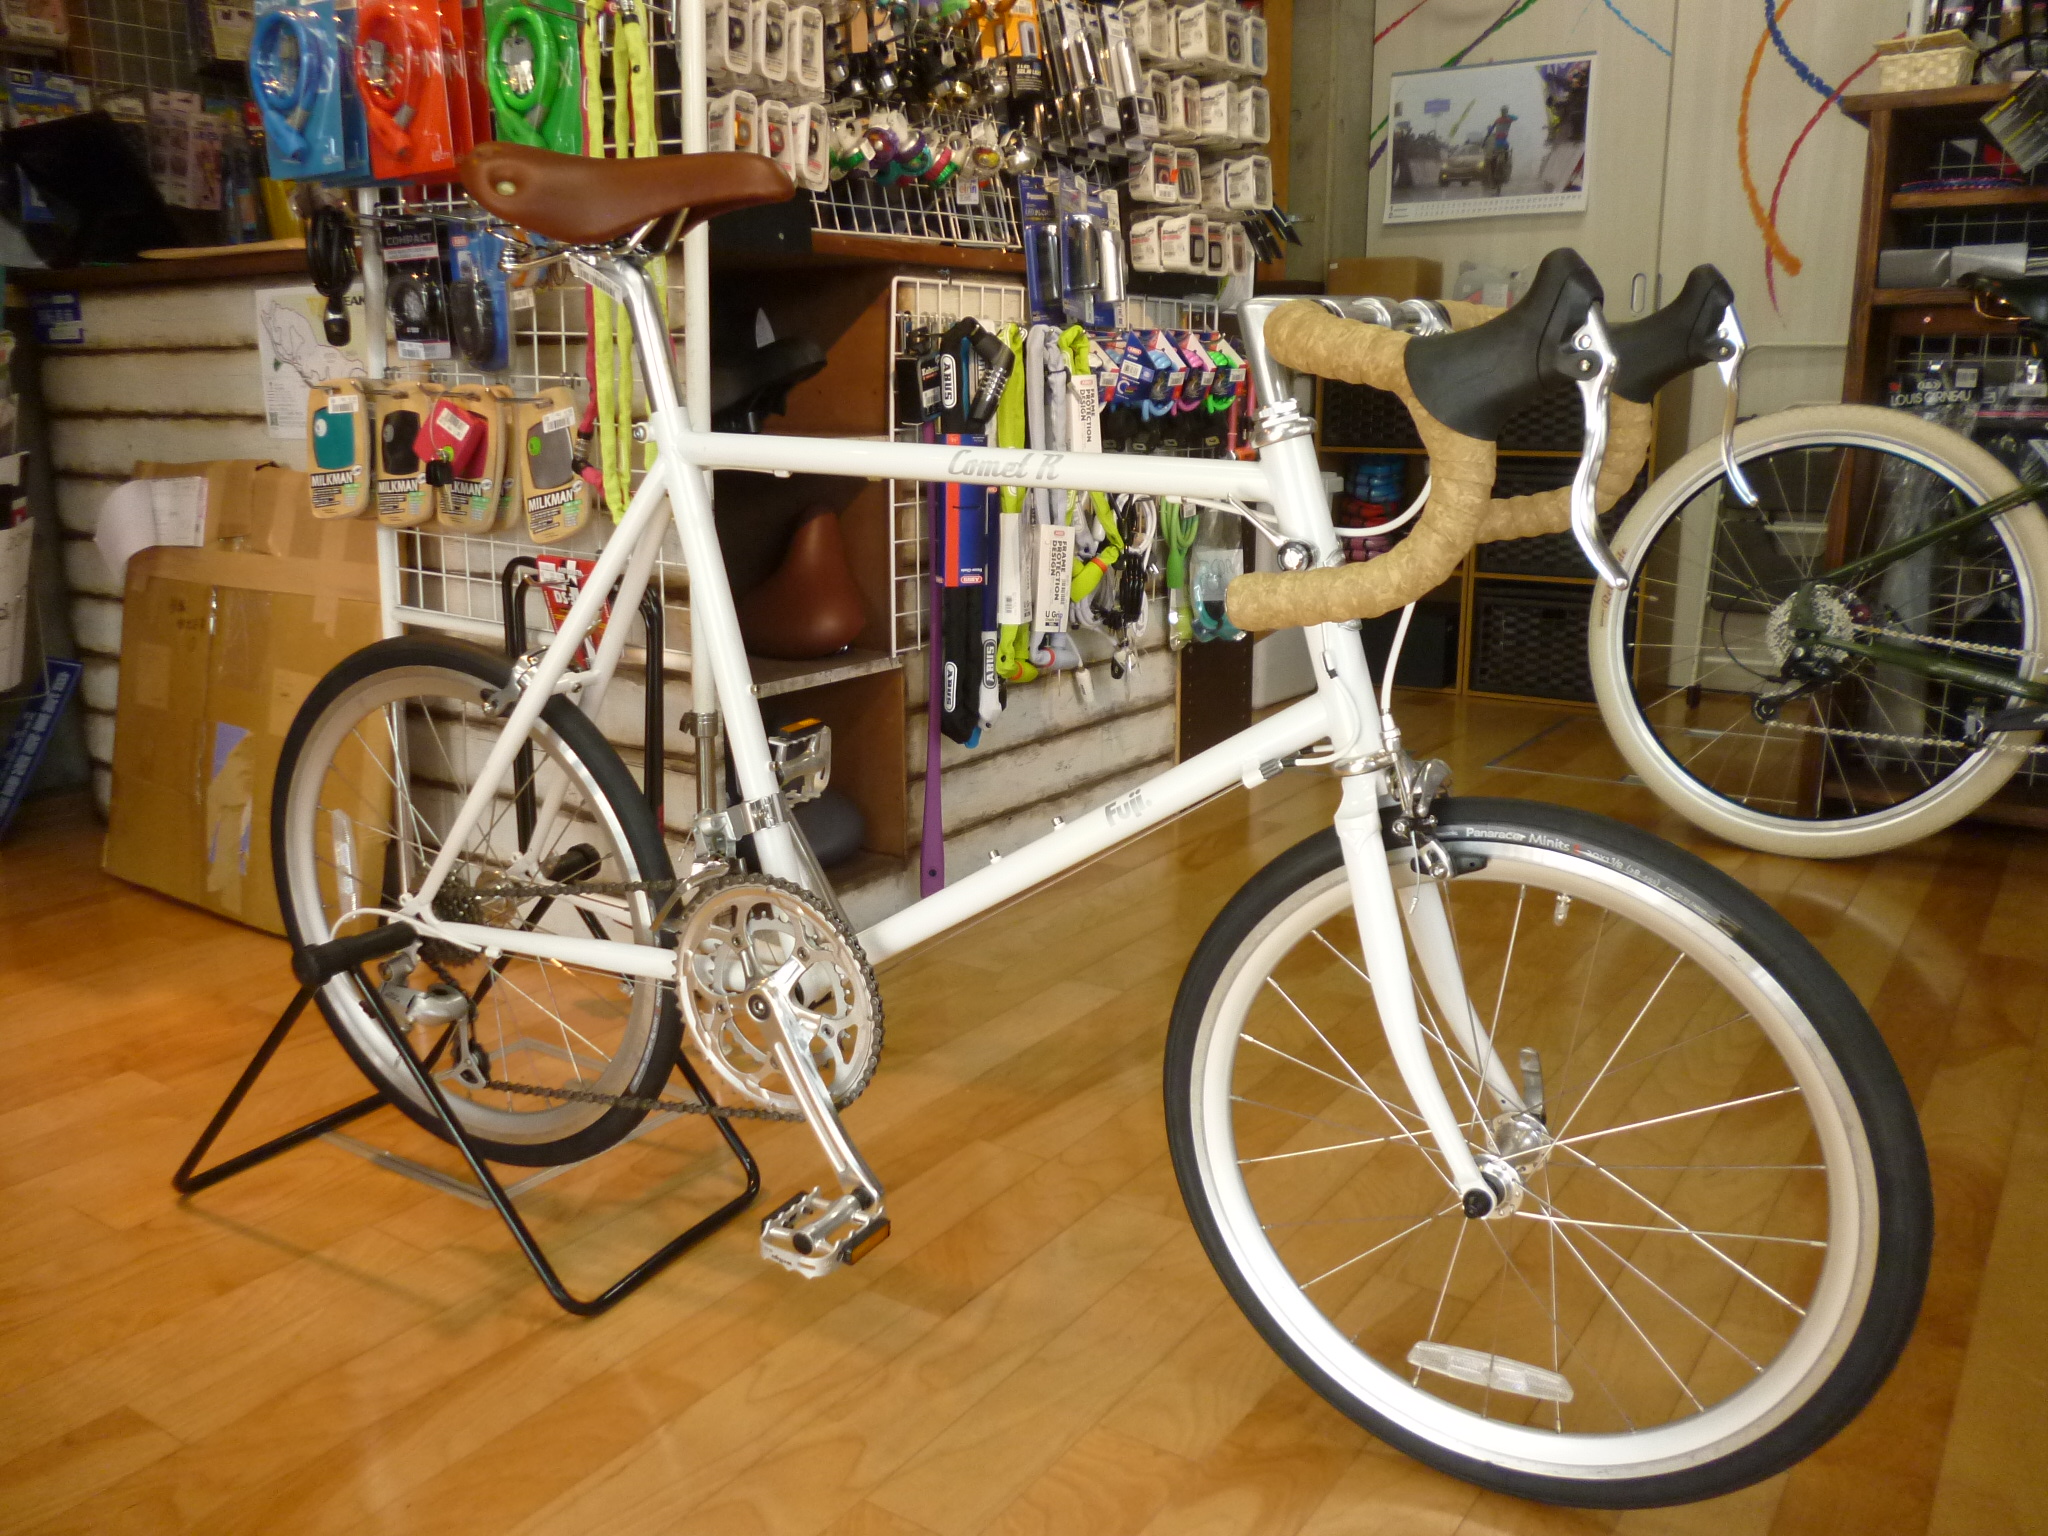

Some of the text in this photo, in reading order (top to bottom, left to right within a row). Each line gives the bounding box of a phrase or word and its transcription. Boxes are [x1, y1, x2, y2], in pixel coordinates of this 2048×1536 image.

[385, 233, 432, 246] COMPACT
[943, 362, 953, 400] ABUS
[1890, 392, 1923, 407] LOUIS
[311, 471, 353, 487] MILKMAN
[1035, 453, 1065, 480] R
[378, 479, 418, 494] MILKMAN
[450, 480, 482, 497] LKMAN
[528, 488, 574, 513] MILKMAN
[1054, 540, 1062, 601] PROTECTION
[986, 645, 995, 682] ABUS
[946, 670, 954, 705] ABUS
[1465, 827, 1527, 842] Panaracer
[1528, 833, 1571, 852] Minits
